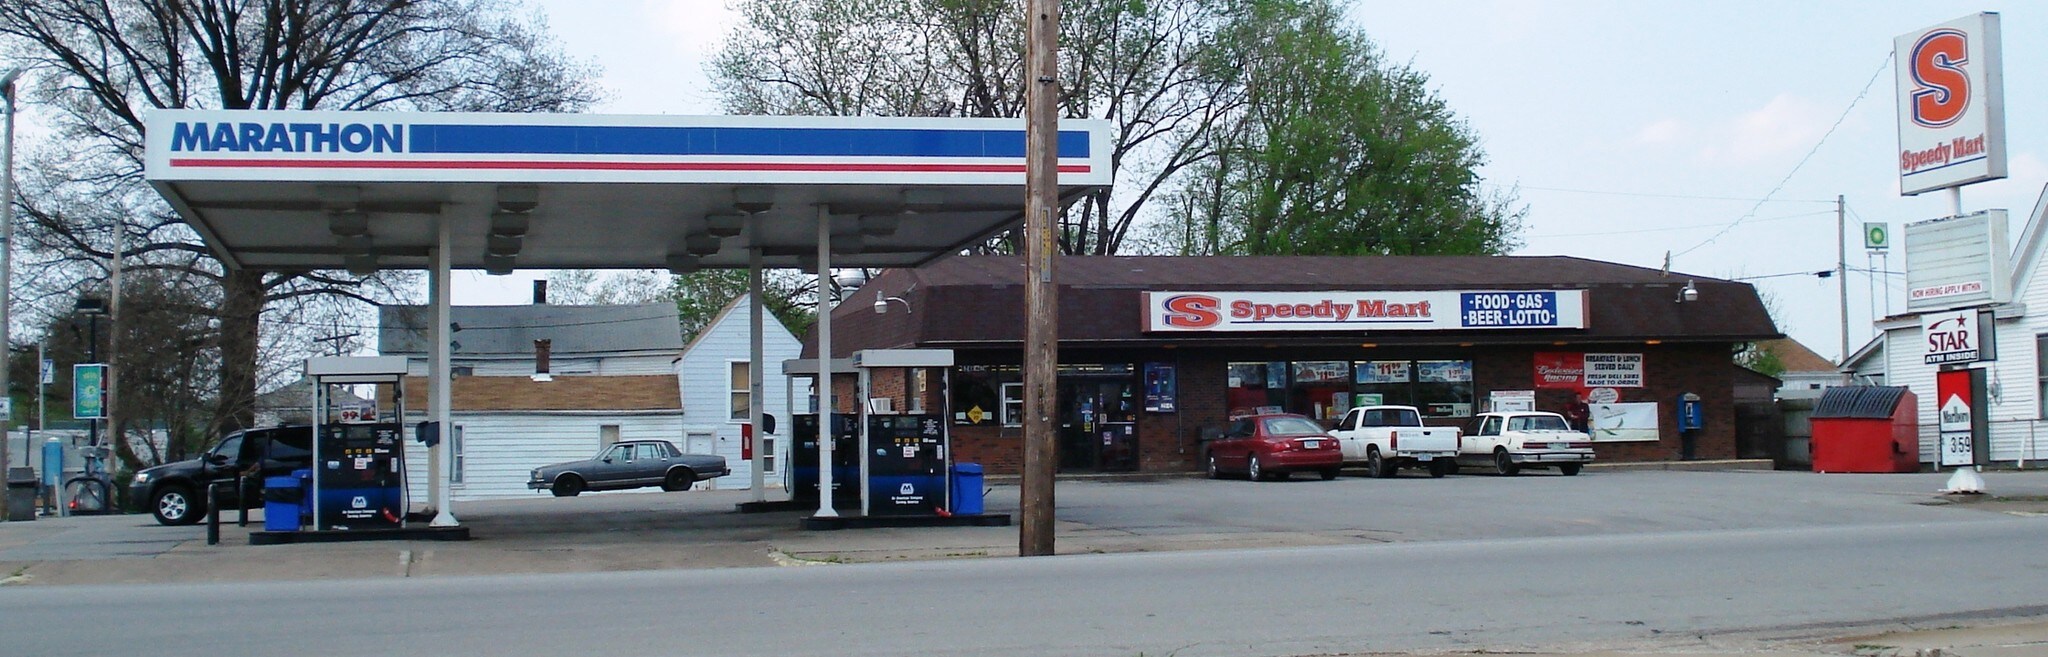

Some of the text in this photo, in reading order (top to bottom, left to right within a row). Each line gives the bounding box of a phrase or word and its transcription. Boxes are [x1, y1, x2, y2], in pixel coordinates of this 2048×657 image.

[1909, 28, 1972, 129] S
[170, 122, 403, 153] MARATHON
[1902, 133, 1986, 171] Speedy Mart
[1912, 282, 1981, 298] NOW HIRING APPLY WITHIN
[1475, 294, 1543, 309] FOOD GAS
[1162, 294, 1222, 329] S
[1230, 299, 1431, 322] Speedy Mart
[1468, 309, 1551, 325] BEER LOTTO
[1928, 330, 1969, 353] STAR
[1926, 351, 1977, 363] ATM INSIDE
[1594, 363, 1635, 371] SERVED DAILY
[1544, 374, 1578, 382] Racing
[1943, 406, 1970, 423] Marlboro
